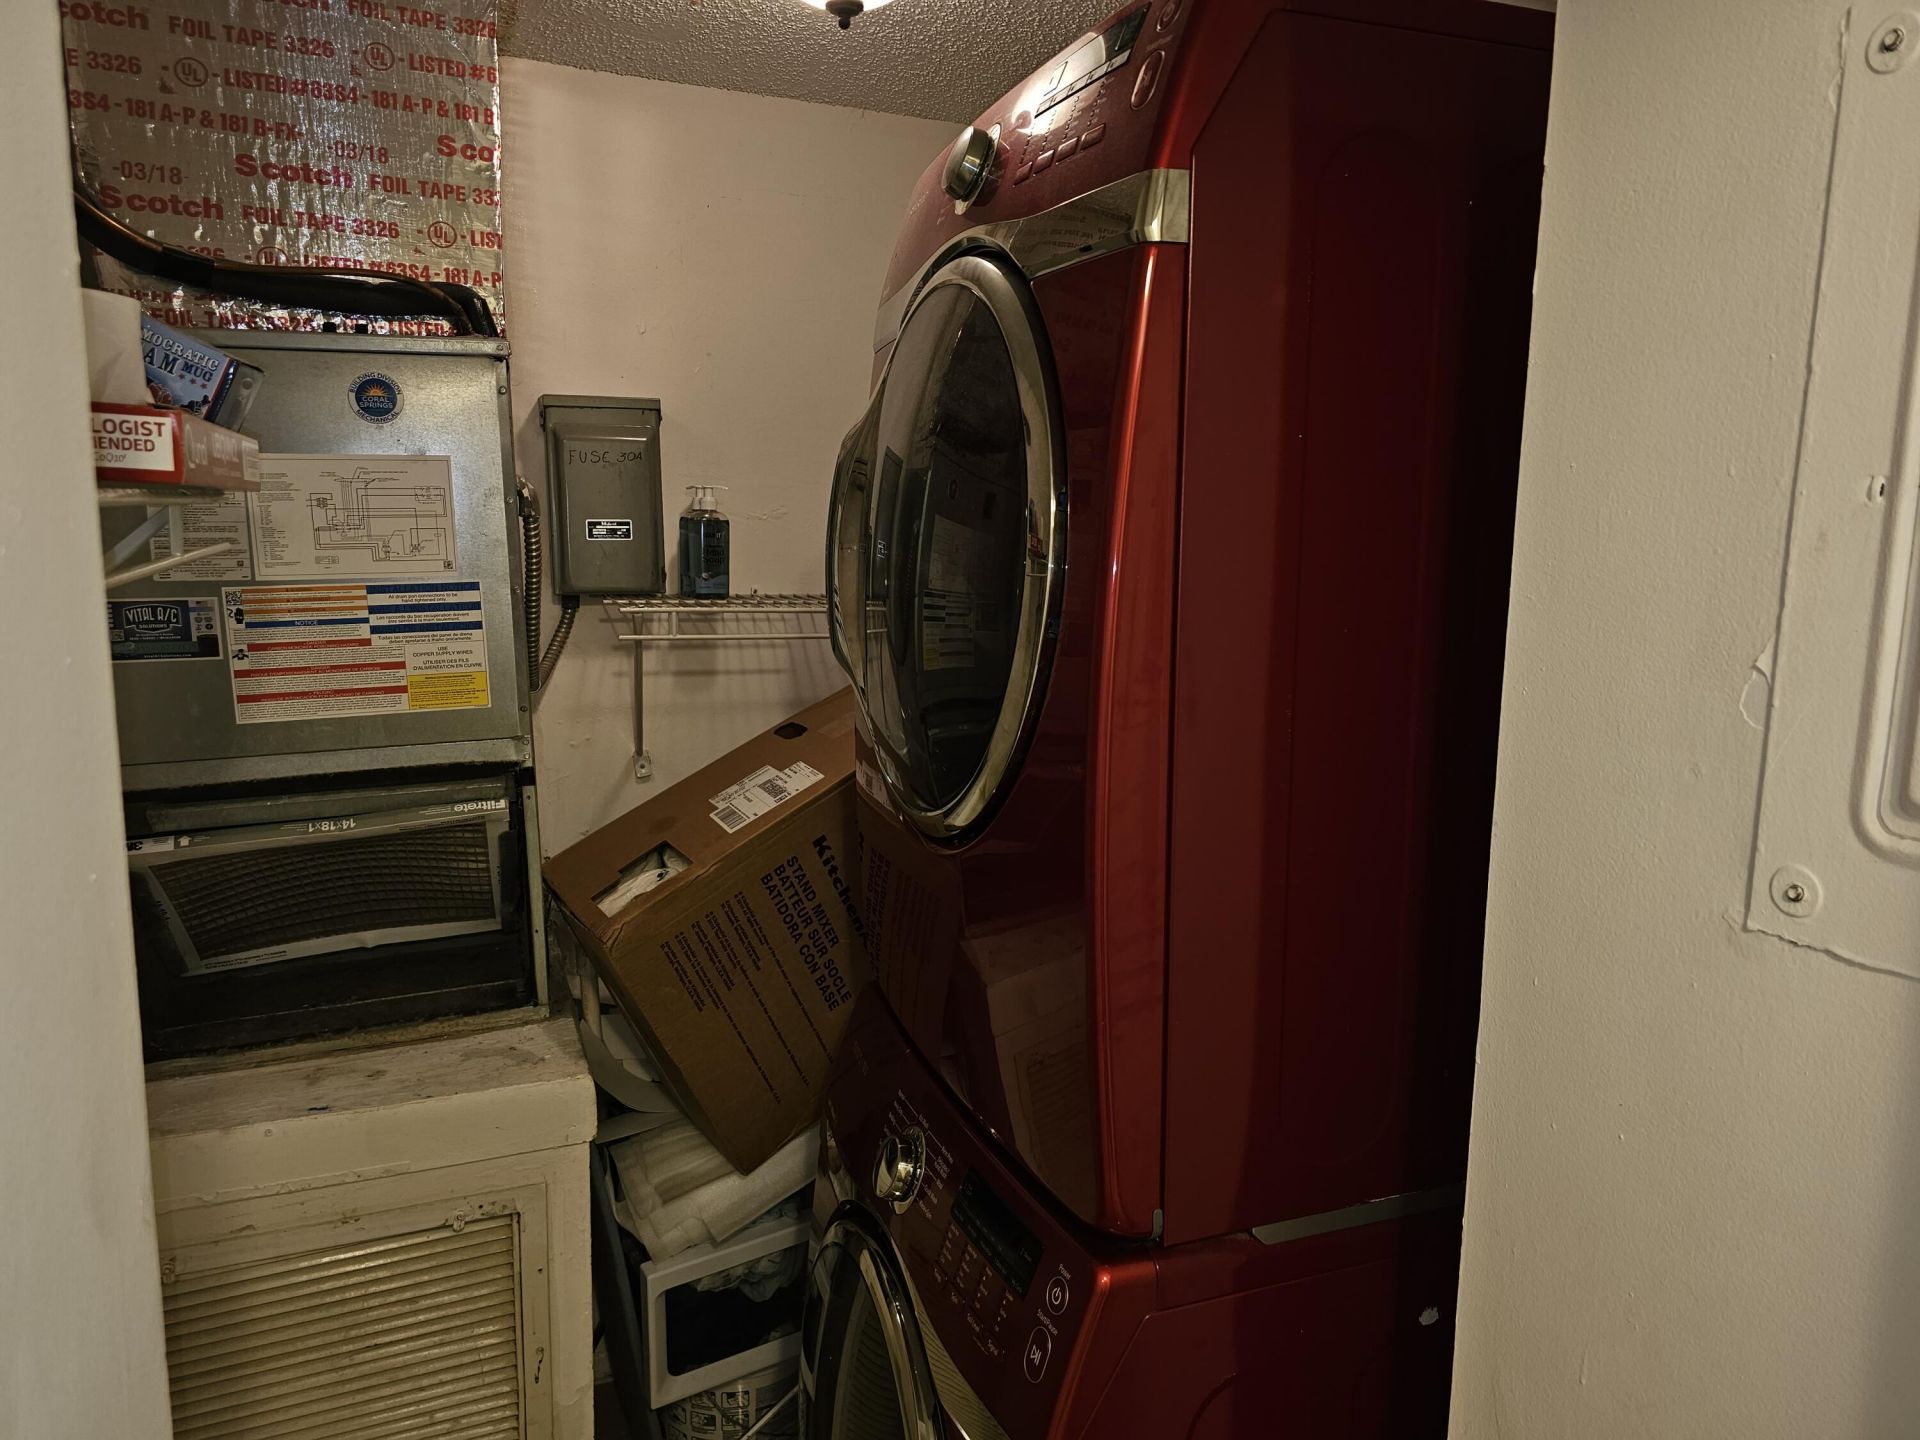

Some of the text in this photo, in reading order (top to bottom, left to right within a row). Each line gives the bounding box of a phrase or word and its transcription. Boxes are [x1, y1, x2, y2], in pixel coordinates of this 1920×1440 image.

[348, 0, 391, 21] FOIL
[396, 6, 446, 31] TAPE
[452, 17, 497, 39] 3326
[169, 16, 216, 42] FOIL
[222, 25, 278, 50] TAPE
[284, 35, 336, 58] 3326
[409, 53, 467, 78] LISTED
[87, 51, 142, 75] 3326
[224, 68, 289, 94] LISTED
[371, 90, 398, 110] 181
[437, 102, 449, 118] &
[454, 103, 479, 123] 181
[125, 98, 155, 120] 181
[199, 110, 214, 129] &
[219, 114, 248, 134] 181
[235, 154, 351, 189] Scotch
[370, 174, 412, 196] FOIL
[417, 180, 466, 203] TAPE
[100, 184, 223, 220] Scotch
[242, 205, 288, 227] FOIL
[293, 210, 345, 234] TAPE
[353, 217, 400, 239] 3326
[181, 361, 214, 382] MUG
[359, 401, 393, 409] SPRINGS
[92, 417, 166, 437] LOGIST
[568, 449, 643, 465] FUSE 30A
[125, 607, 155, 623] VITAL
[157, 607, 178, 623] A/C
[295, 619, 318, 627] NOTICE
[453, 799, 506, 813] Filtrete
[306, 817, 357, 833] 14x18x1
[788, 856, 839, 945] STAND MIXER
[760, 873, 841, 1011] BATIDORA CON BASE
[774, 864, 853, 1004] BATTEUR SUR SOCLE
